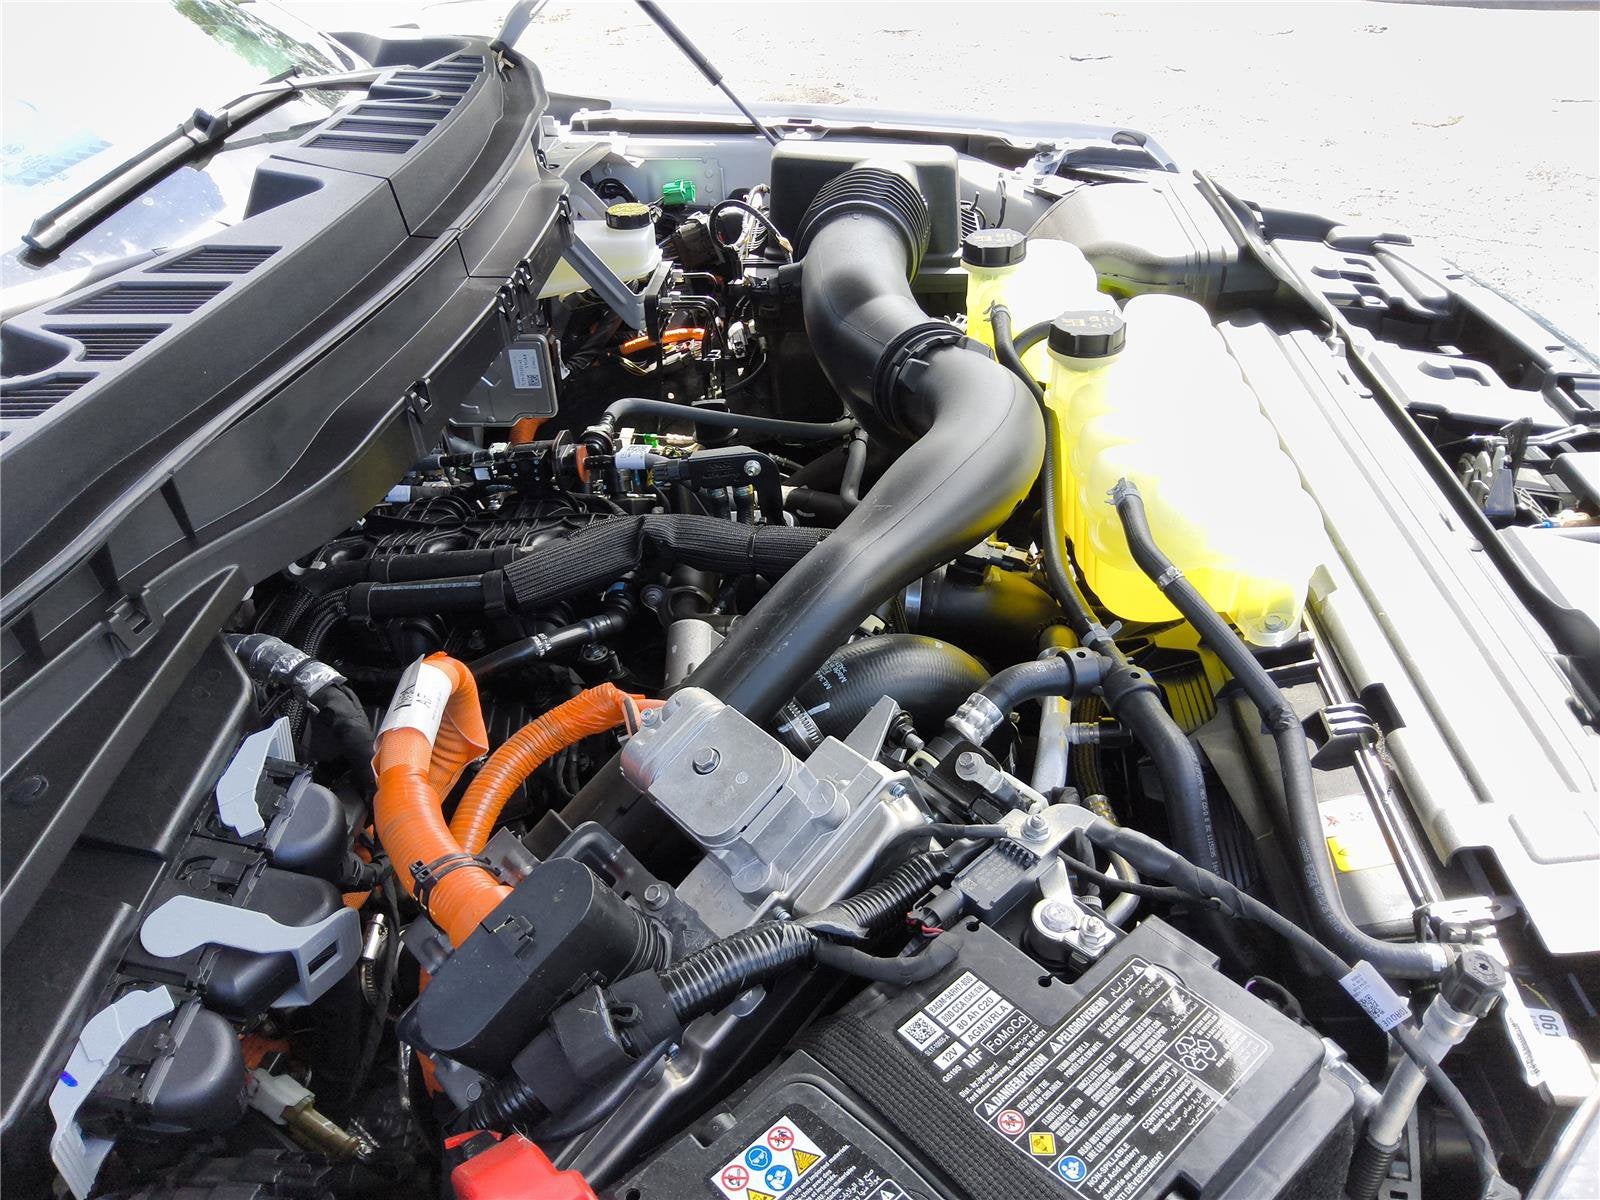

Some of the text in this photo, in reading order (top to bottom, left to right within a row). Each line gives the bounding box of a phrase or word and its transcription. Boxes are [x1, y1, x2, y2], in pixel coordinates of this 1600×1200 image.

[940, 1010, 955, 1022] 800
[951, 1000, 967, 1013] CCA
[955, 996, 994, 1030] 80 Ah C20
[965, 1004, 1008, 1041] AGM/VRLA
[1055, 995, 1109, 1045] PELIGRO/VENENO
[1380, 1005, 1408, 1029] TORQUE
[1538, 1014, 1560, 1036] 061
[985, 1013, 1028, 1051] FoMoCo
[941, 1047, 959, 1063] 12V
[961, 1047, 986, 1068] MF
[1189, 1046, 1202, 1057] Pb
[965, 1091, 979, 1104] Ford
[975, 1080, 991, 1094] Motor
[987, 1063, 1011, 1084] Company,
[1006, 1044, 1030, 1066] Dearborn,
[1025, 1039, 1035, 1047] MI
[990, 1052, 1049, 1106] DANGER/POISON
[958, 1085, 972, 1098] Dist.
[1015, 1078, 1050, 1110] KEEP OUT OF THE
[1023, 1101, 1040, 1116] REACH
[1035, 1096, 1045, 1105] OF
[1070, 1097, 1084, 1109] WITH
[1125, 1095, 1138, 1106] LEA
[1132, 1087, 1145, 1098] LAS
[1140, 1078, 1191, 1129] CONTRA DERRAMES
[1062, 1125, 1081, 1143] MEDICAL
[1076, 1116, 1090, 1128] HELP
[1067, 1114, 1079, 1124] GET
[1076, 1111, 1122, 1156] READ INSTRUCTIONS.
[1084, 1111, 1135, 1162] LIRE LES INSTRUCTIONS.
[792, 1186, 801, 1195] US
[799, 1179, 810, 1189] and
[808, 1161, 830, 1181] imported
[827, 1142, 850, 1163] materials.
[811, 1176, 824, 1188] avec
[822, 1168, 832, 1178] des
[824, 1185, 834, 1195] con
[832, 1164, 856, 1187] materiales
[1085, 1142, 1131, 1187] NON-SPILLABLE
[1093, 1146, 1140, 1193] Lead Acid Battery
[1102, 1153, 1150, 1200] Batterie au plomb
[1122, 1150, 1165, 1194] DÉVERSEMENT
